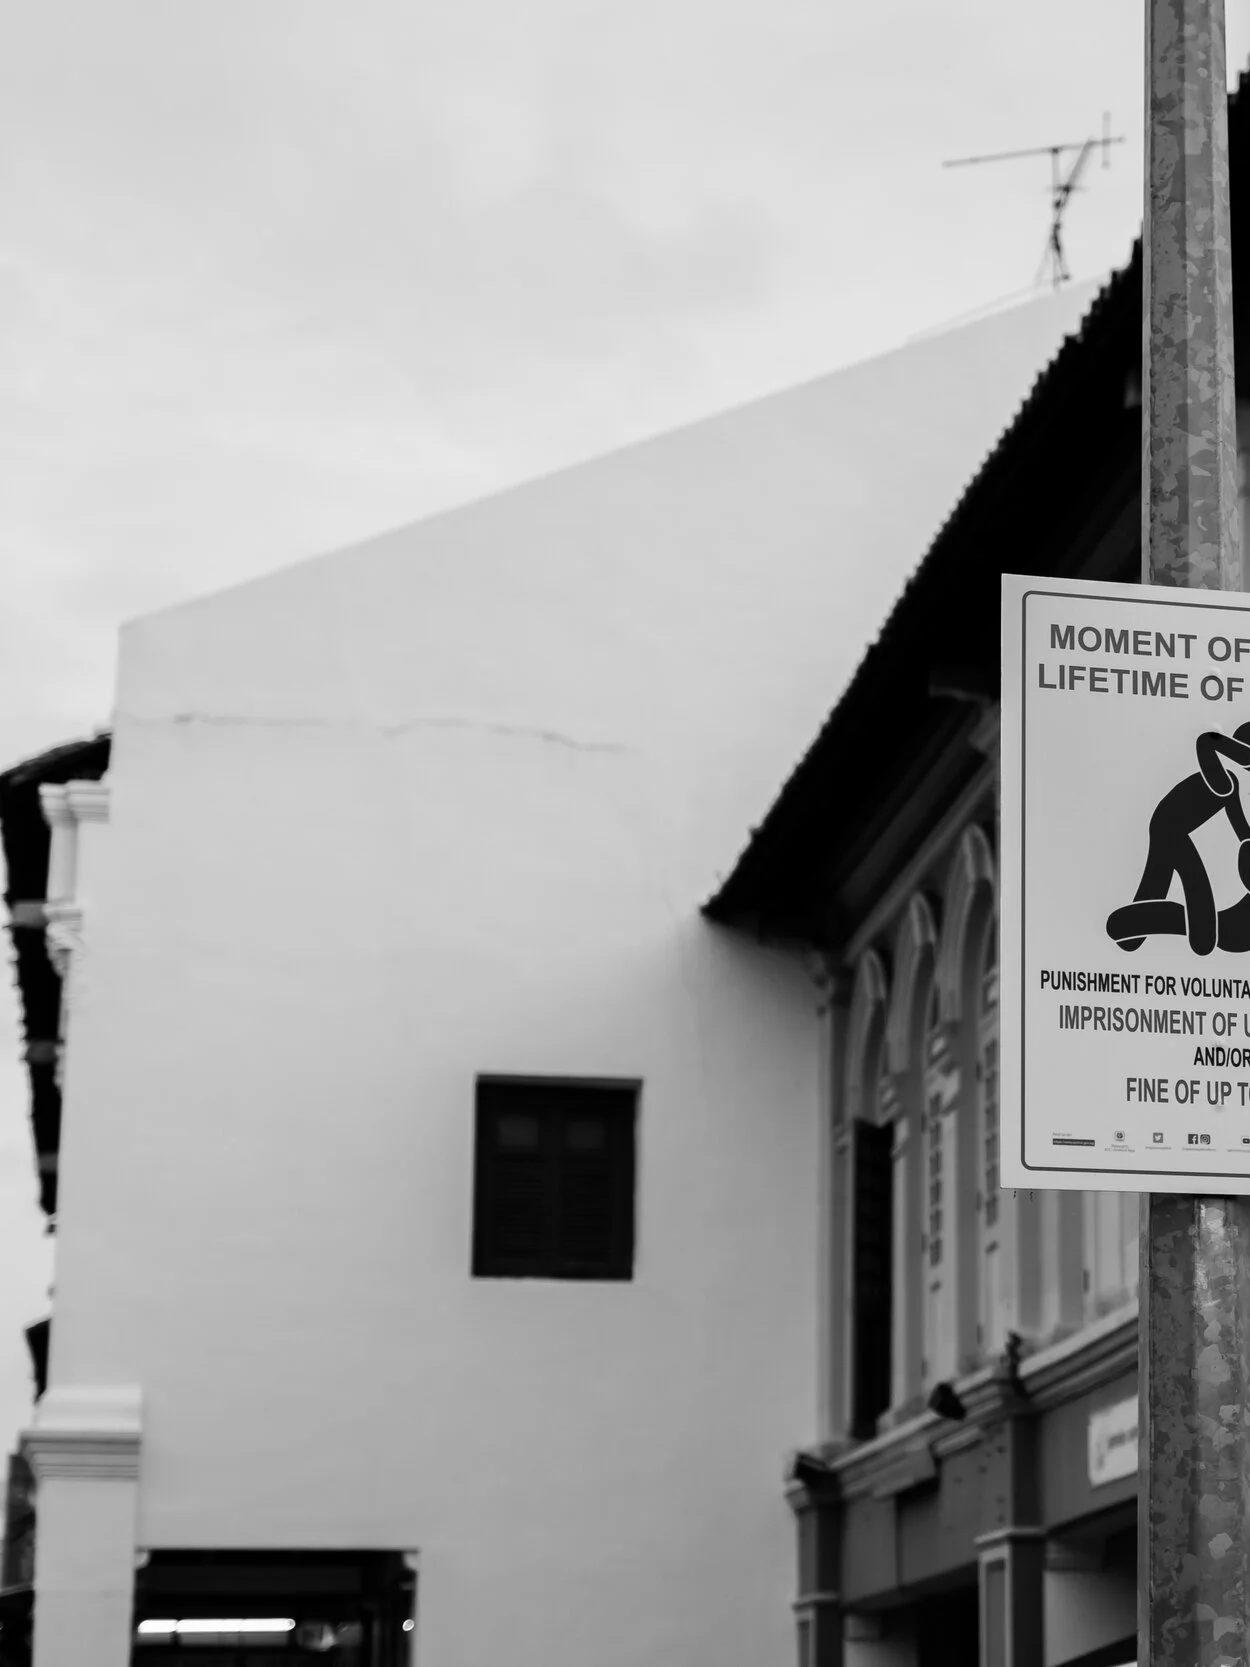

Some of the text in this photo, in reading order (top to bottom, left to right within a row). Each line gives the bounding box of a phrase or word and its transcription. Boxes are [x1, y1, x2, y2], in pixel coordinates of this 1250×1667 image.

[1051, 624, 1198, 659] MOMENT
[1039, 664, 1189, 699] LIFETIME
[1201, 675, 1244, 702] OF
[1041, 969, 1141, 994] PUNISHMENT
[1146, 975, 1177, 996] FOR
[1060, 1005, 1207, 1036] IMPRISONMENT
[1213, 1012, 1238, 1037] OF
[1127, 1078, 1169, 1103] FINE
[1175, 1080, 1201, 1104] OF
[1207, 1081, 1232, 1106] UP
